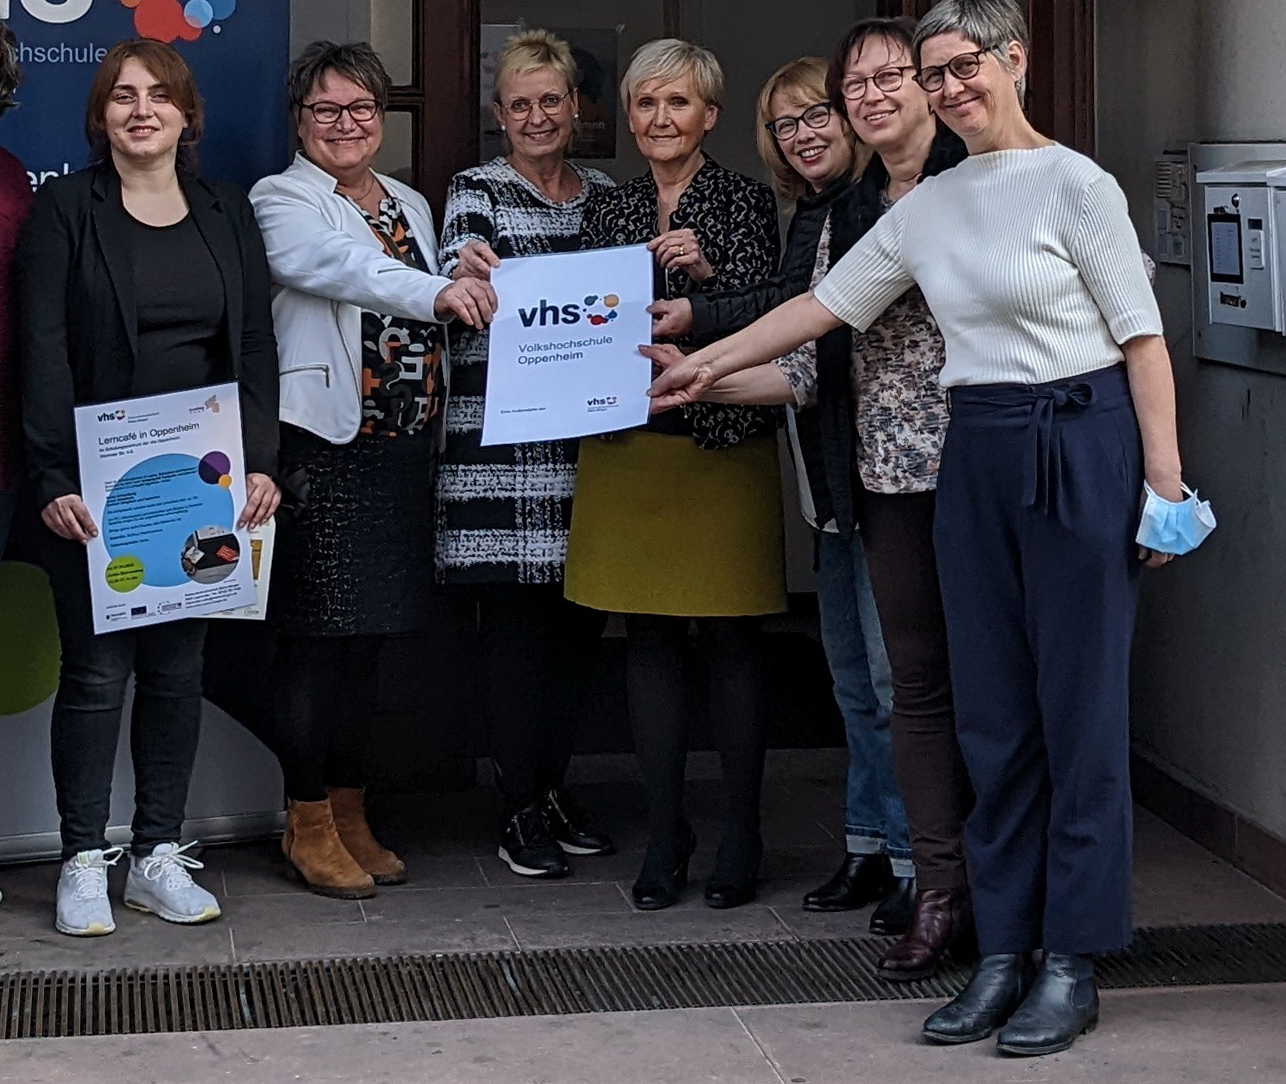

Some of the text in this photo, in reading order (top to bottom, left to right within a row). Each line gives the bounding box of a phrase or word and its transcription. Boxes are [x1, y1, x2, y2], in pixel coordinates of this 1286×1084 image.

[518, 299, 580, 328] vhs
[518, 336, 613, 353] Volkshochschule
[518, 351, 584, 365] Oppenheim
[587, 397, 606, 406] vhs
[97, 411, 115, 422] vhs
[98, 422, 200, 446] Lerncafé in Oppenheim
